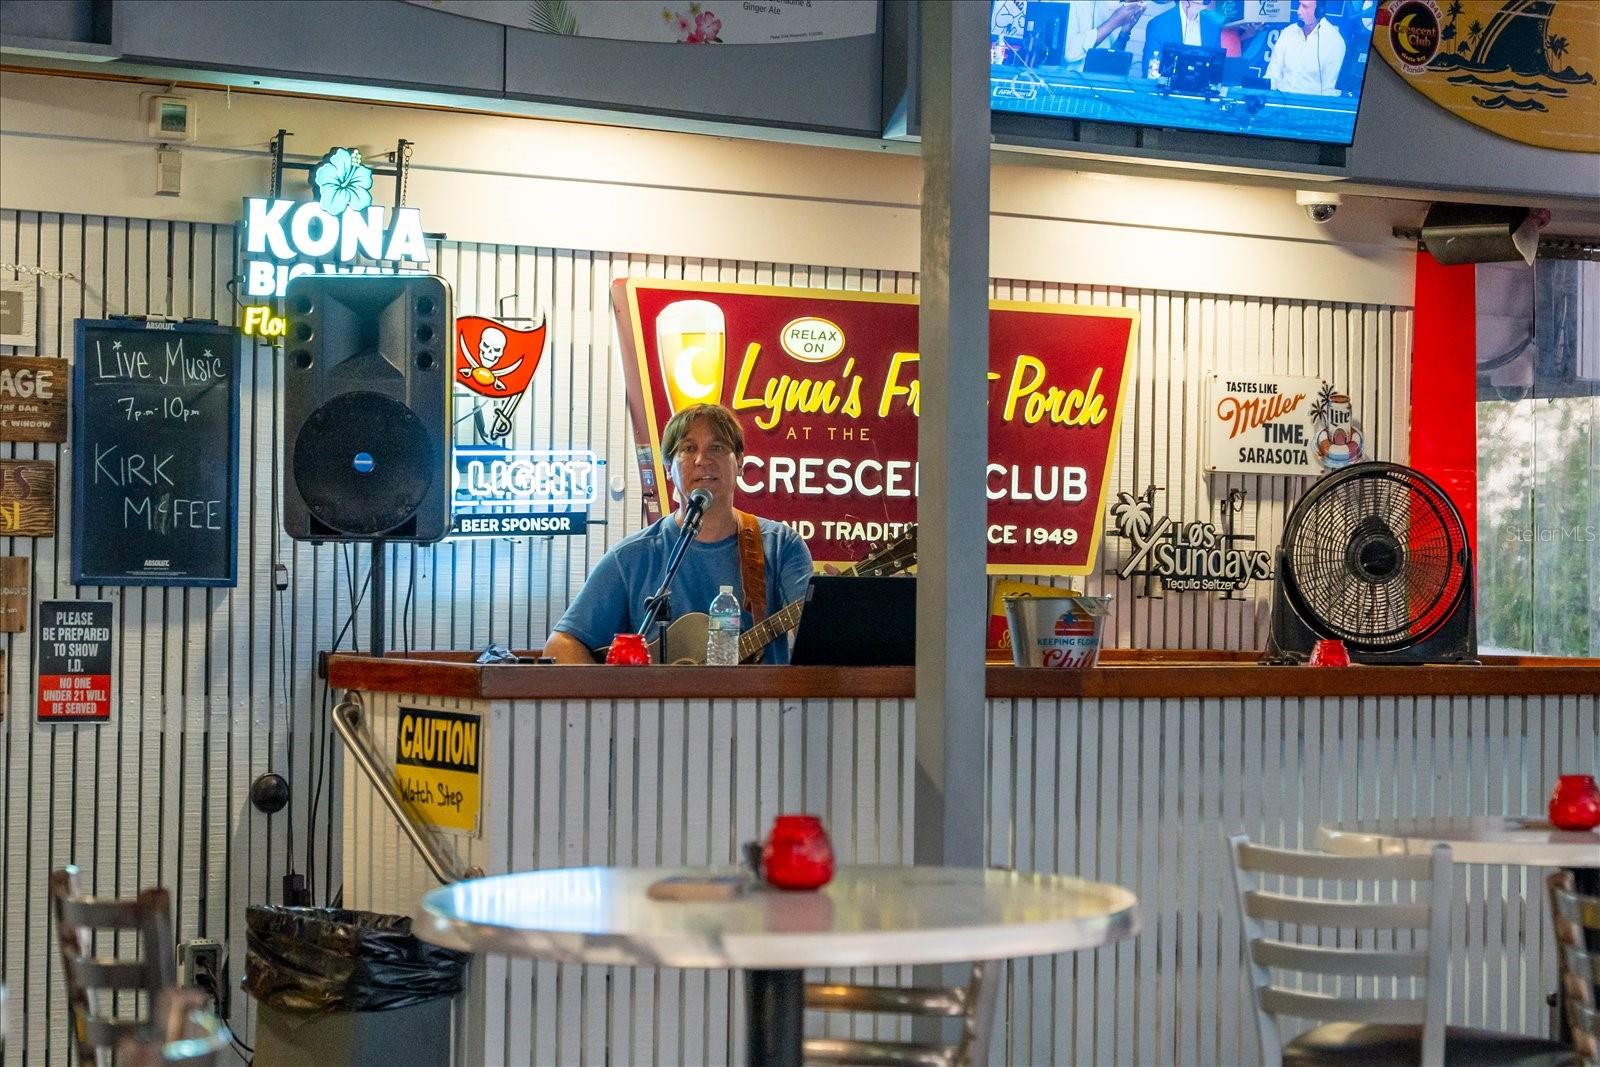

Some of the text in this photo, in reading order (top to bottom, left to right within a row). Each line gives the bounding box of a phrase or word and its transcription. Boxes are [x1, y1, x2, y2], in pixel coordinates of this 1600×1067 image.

[743, 2, 766, 14] Ginger
[768, 6, 780, 15] Ale
[1408, 35, 1431, 46] Club
[1402, 64, 1424, 73] Florida
[247, 198, 430, 262] KONA
[790, 329, 838, 342] RELAX
[804, 342, 824, 353] ON
[96, 338, 226, 386] Live Music
[732, 342, 863, 430] Lynn's
[1003, 354, 1108, 426] Porch
[1226, 382, 1278, 394] TASTES LIKE
[11, 420, 52, 428] WINDOW
[1217, 393, 1306, 440] Miller
[1328, 408, 1350, 427] Lite
[786, 426, 870, 441] AT THE
[1262, 422, 1310, 446] TIME,
[1239, 447, 1308, 465] SARASOTA
[94, 442, 174, 486] KIRK
[468, 460, 592, 497] LIGHT
[736, 455, 1088, 502] CRESCE CLUB
[461, 518, 499, 532] BEER
[502, 516, 570, 532] SPONSOR
[986, 524, 1018, 544] CE
[1025, 527, 1078, 545] 1949
[1166, 578, 1236, 591] Tequila Seltzer
[56, 611, 94, 626] PLEASE
[42, 627, 109, 641] BE PREPARED
[53, 643, 98, 657] TO SHOW
[67, 659, 84, 672] I.D.
[60, 677, 91, 689] NO ONE
[43, 690, 106, 701] UNDER 21 WILL
[52, 703, 97, 714] BE SERVED
[400, 714, 477, 766] CAUTION
[400, 778, 464, 813] Watch Step
